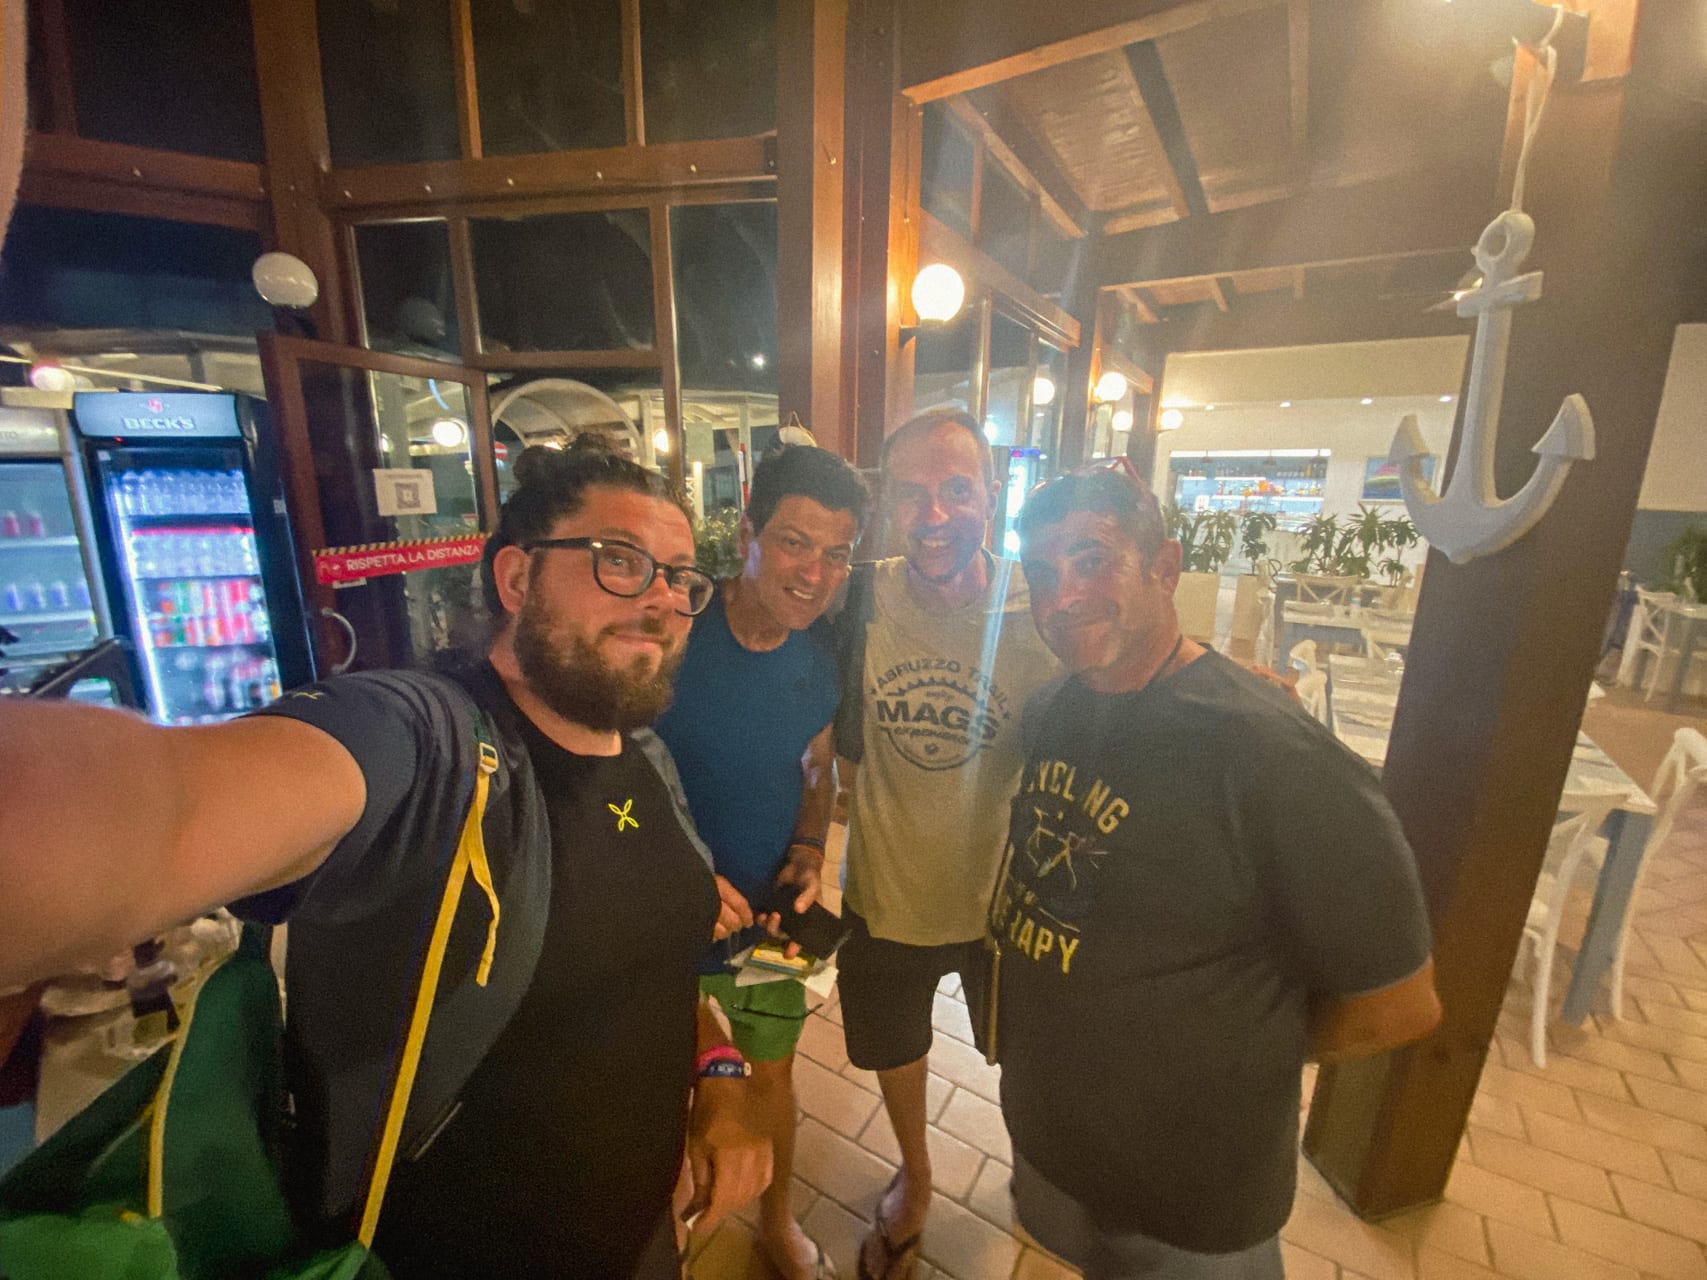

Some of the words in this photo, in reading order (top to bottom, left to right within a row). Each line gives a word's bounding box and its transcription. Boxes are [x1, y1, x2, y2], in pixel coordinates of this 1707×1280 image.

[122, 416, 195, 430] BECK'S
[345, 553, 406, 571] RISPETTA
[408, 550, 425, 563] LA
[427, 545, 481, 561] DISTANZA
[876, 657, 961, 688] ABRUZZO
